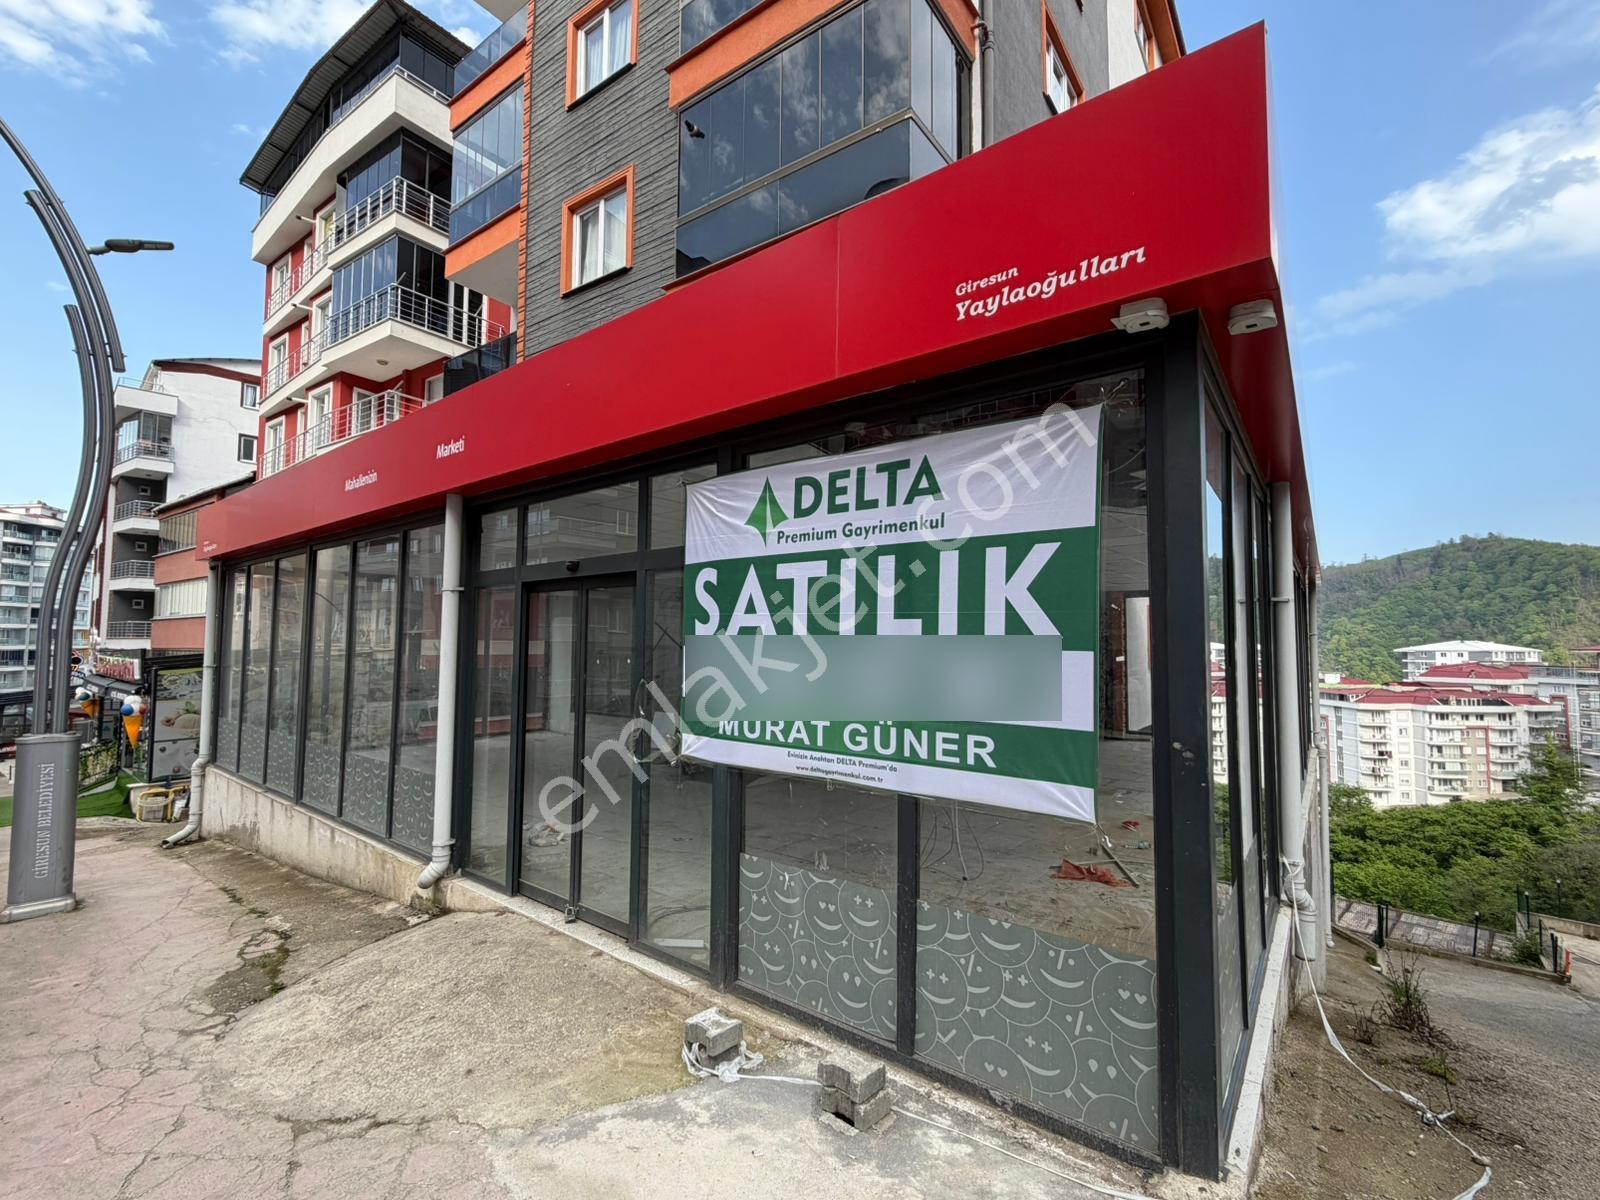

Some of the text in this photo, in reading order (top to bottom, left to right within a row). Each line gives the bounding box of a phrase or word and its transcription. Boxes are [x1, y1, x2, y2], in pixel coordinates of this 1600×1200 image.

[955, 267, 1019, 297] Giresun
[955, 246, 1147, 322] Yaylaoğulları
[436, 435, 465, 460] Marketi
[793, 454, 945, 520] DELTA
[776, 511, 946, 545] Premium Gayrimenkul
[694, 541, 1063, 637] SATILIK
[836, 757, 857, 767] DELTA
[858, 760, 898, 773] Premium'da
[842, 720, 998, 768] GÜNER
[32, 763, 55, 879] GİRESUN BELEDİYESİ
